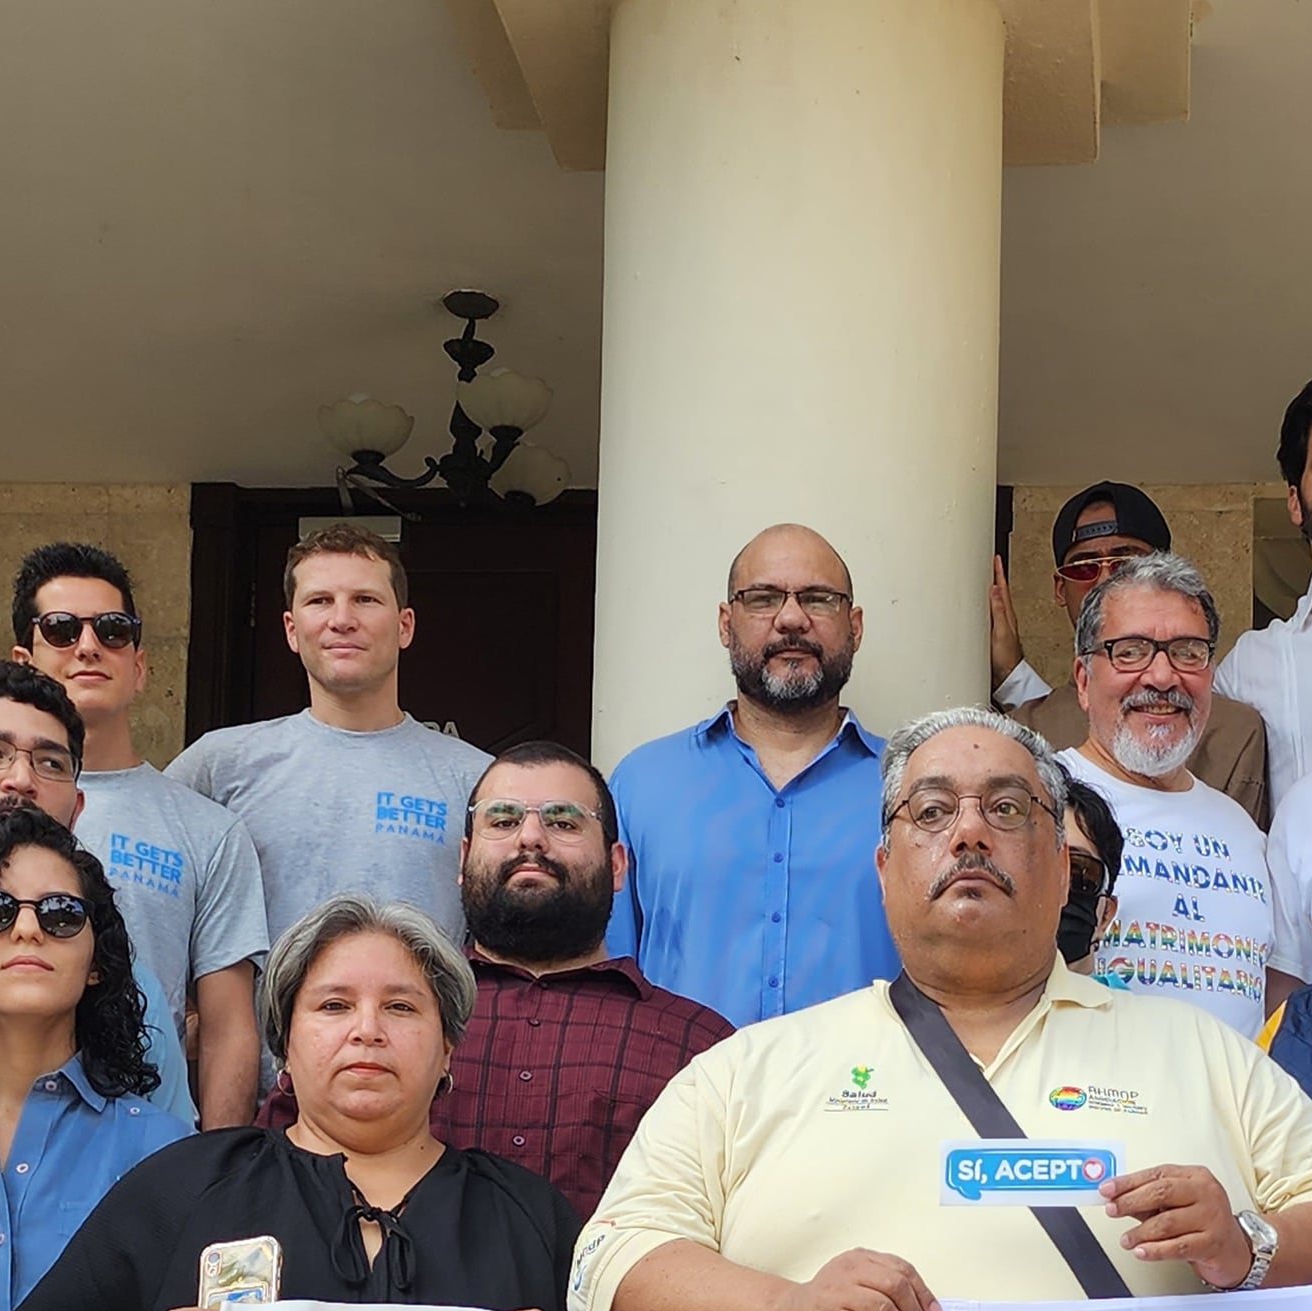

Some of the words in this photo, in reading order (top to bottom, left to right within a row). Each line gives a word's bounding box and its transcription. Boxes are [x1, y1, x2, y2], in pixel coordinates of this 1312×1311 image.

[377, 792, 395, 805] IT
[400, 796, 447, 817] GETS
[377, 806, 446, 832] BETTER
[111, 833, 130, 850] IT
[135, 841, 184, 867] GETS
[1125, 827, 1184, 853] SOY
[1193, 833, 1231, 861] UN
[111, 849, 182, 885] BETTER
[1171, 892, 1206, 922] AL
